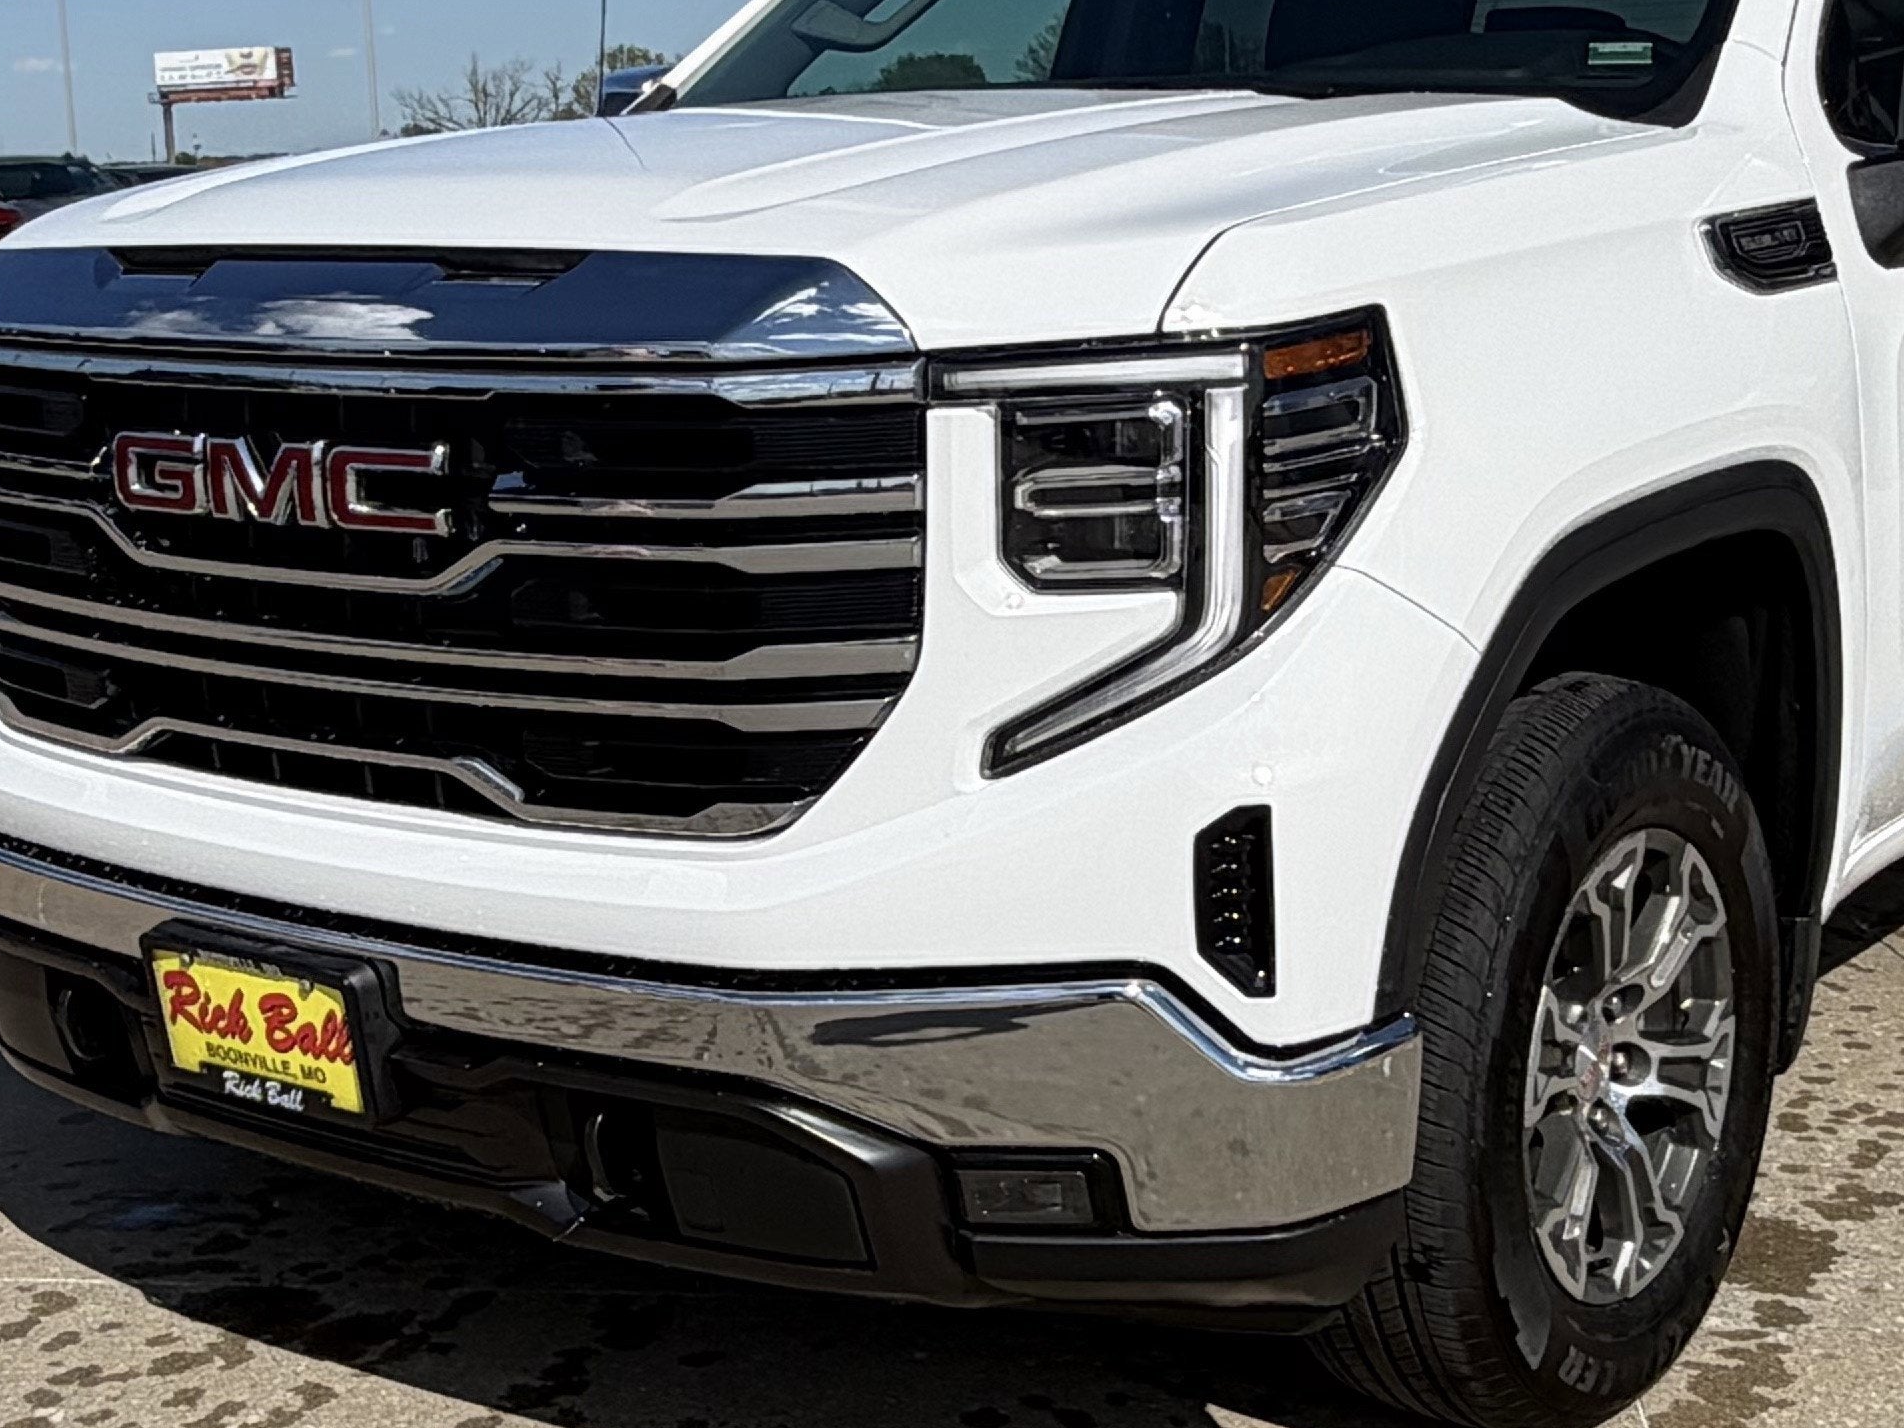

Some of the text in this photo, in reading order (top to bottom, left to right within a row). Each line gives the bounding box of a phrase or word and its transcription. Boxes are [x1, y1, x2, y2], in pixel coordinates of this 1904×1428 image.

[112, 431, 452, 537] GMC
[163, 970, 356, 1065] Rick Ball
[222, 1070, 305, 1112] Rick Ball
[299, 1063, 327, 1084] MO
